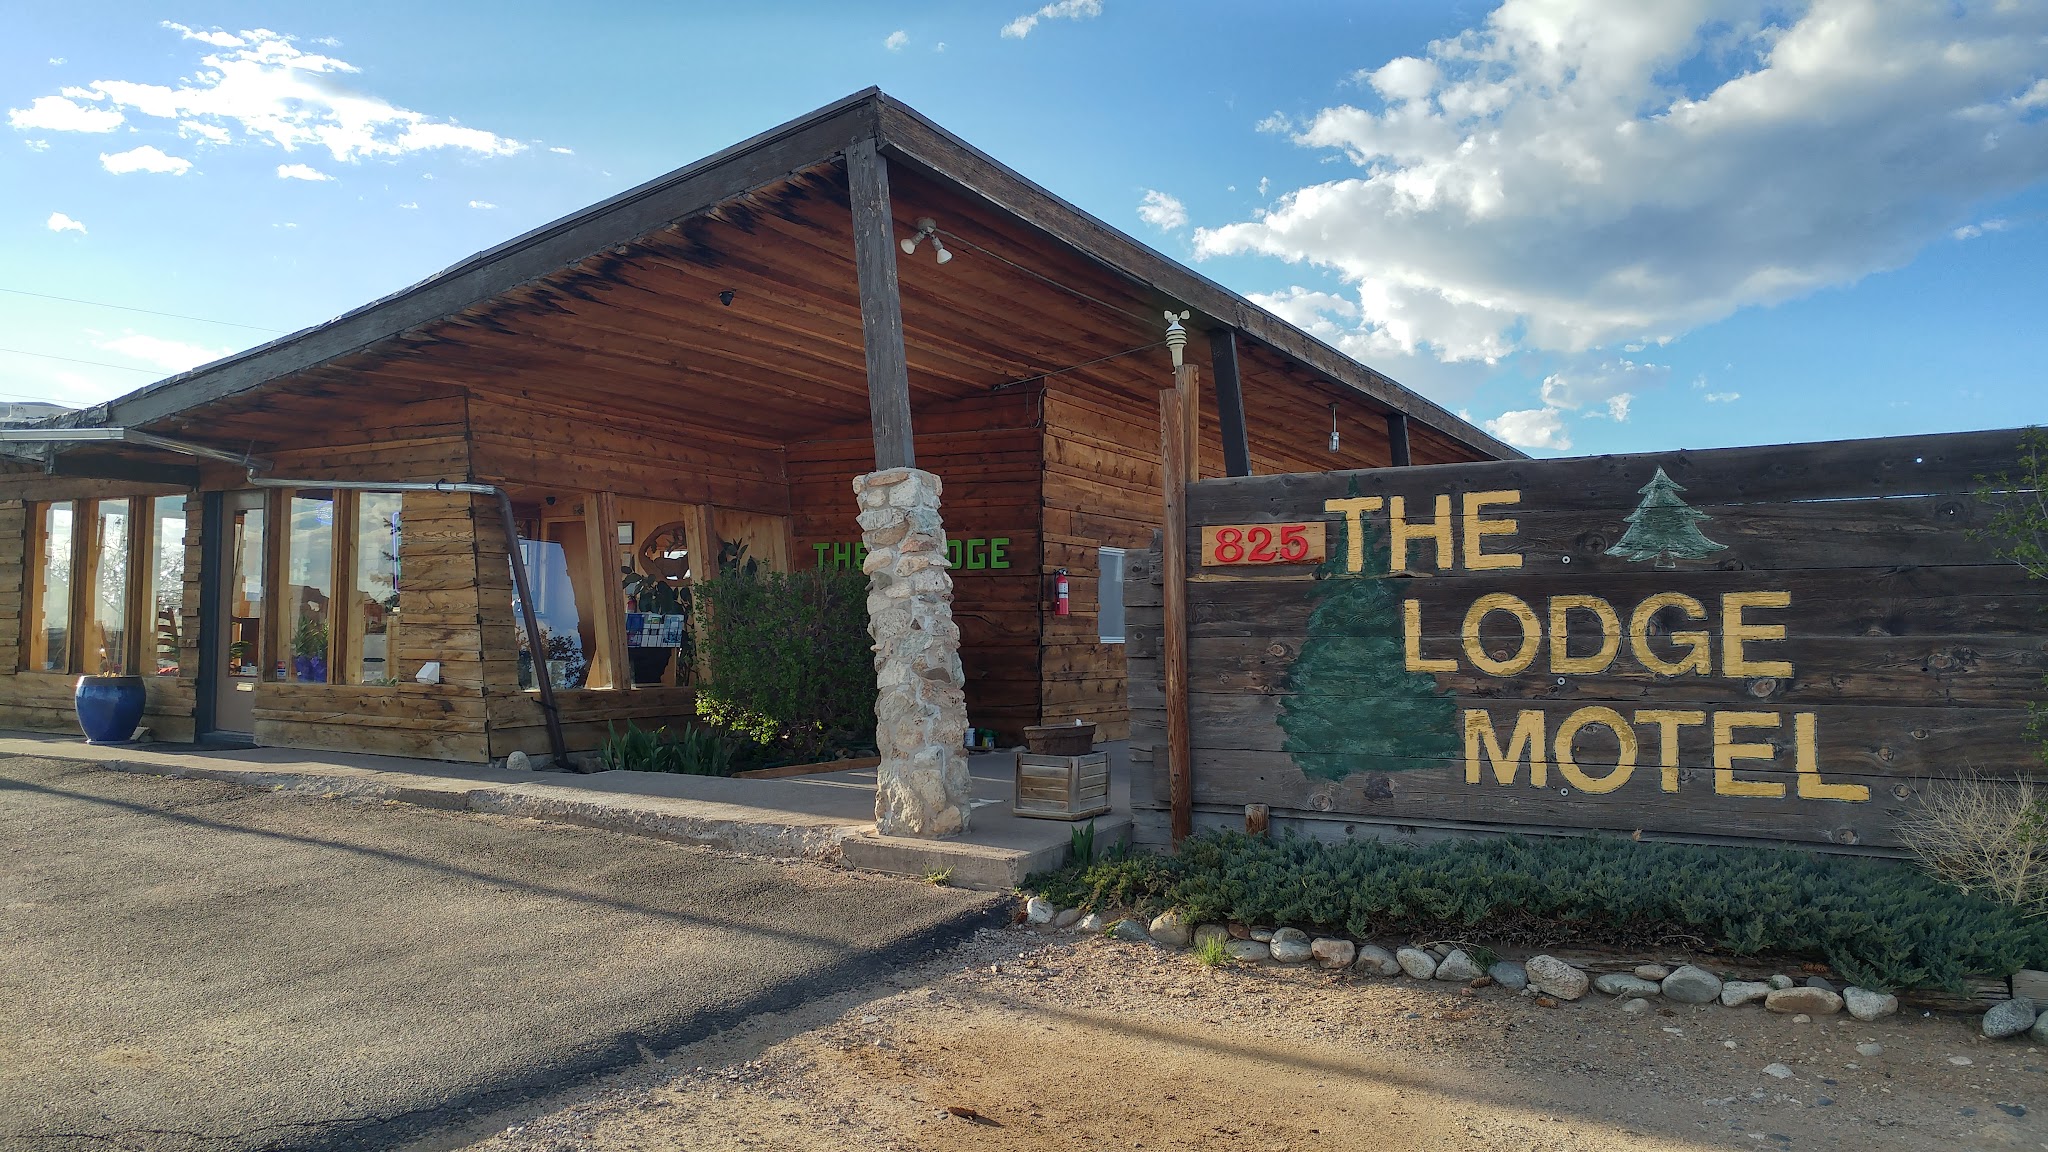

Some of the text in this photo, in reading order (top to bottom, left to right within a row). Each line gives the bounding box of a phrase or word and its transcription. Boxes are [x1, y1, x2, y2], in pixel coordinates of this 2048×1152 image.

[944, 537, 1009, 570] DGE
[1214, 525, 1309, 563] 825
[1324, 490, 1522, 573] THE
[1403, 591, 1795, 678] LODGE
[1463, 705, 1871, 802] MOTEL
